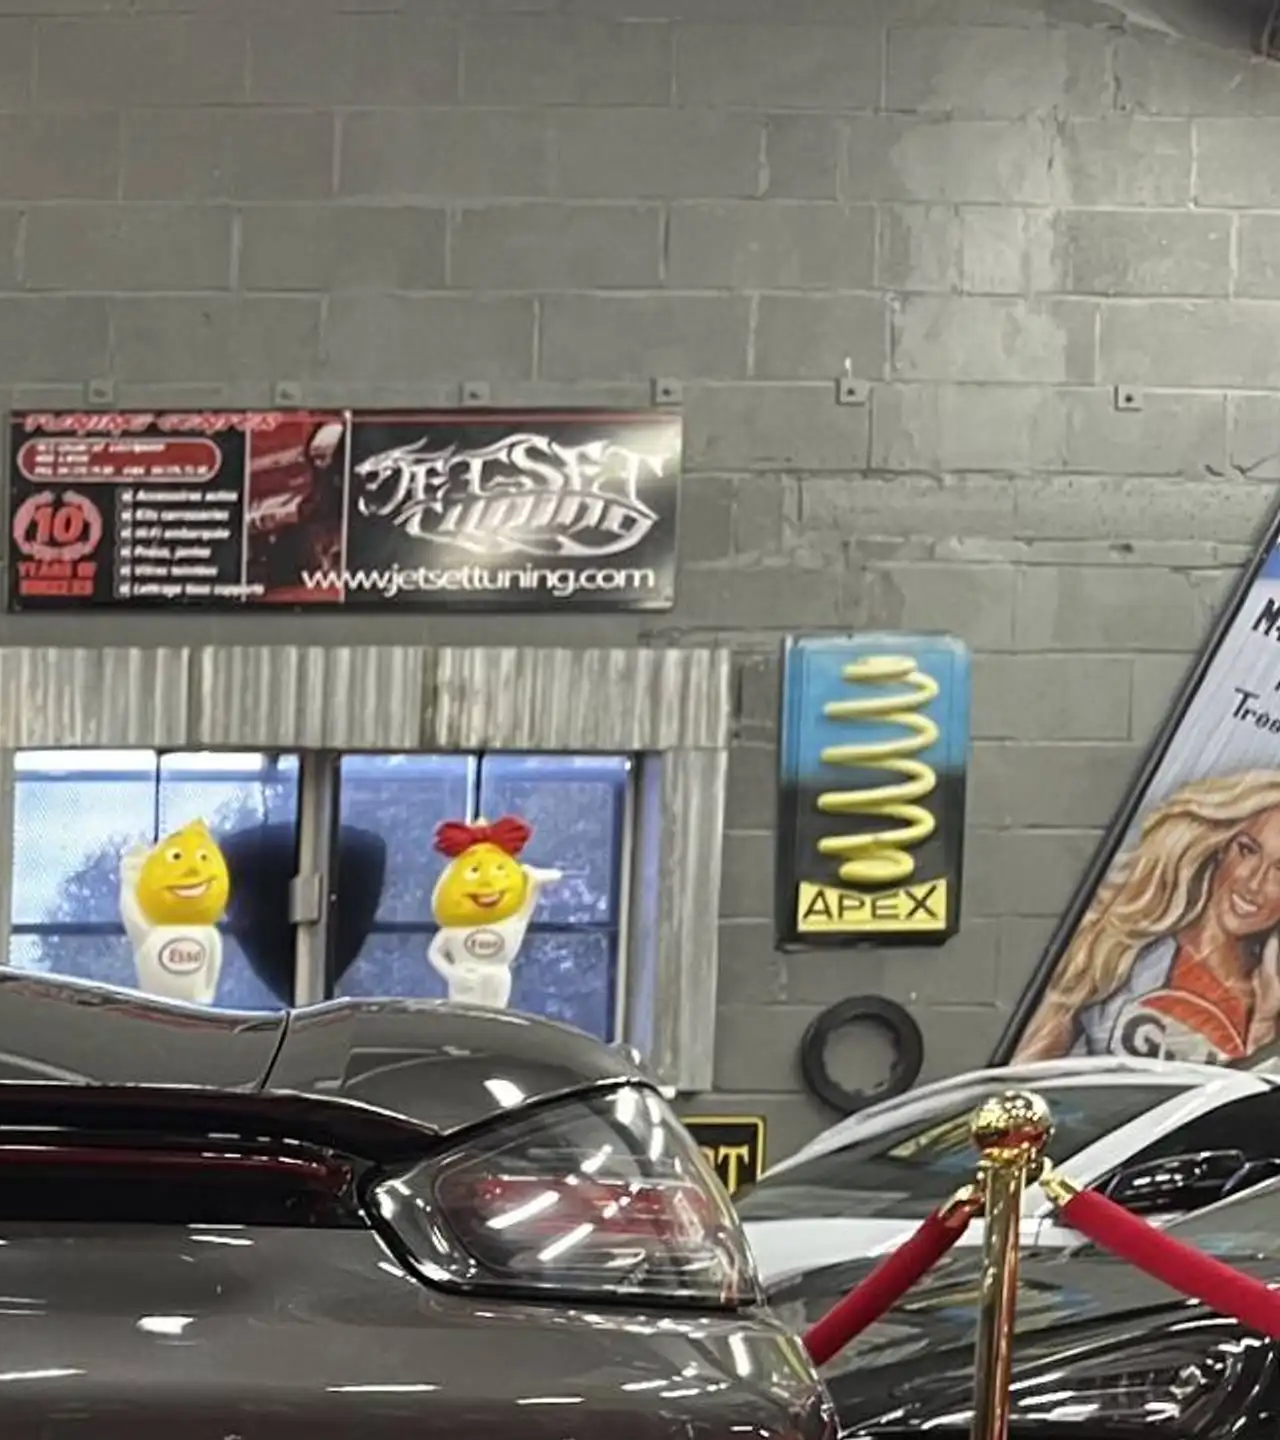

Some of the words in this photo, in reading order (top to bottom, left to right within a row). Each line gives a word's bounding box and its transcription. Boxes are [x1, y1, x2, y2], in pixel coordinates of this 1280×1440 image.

[34, 506, 84, 543] 10
[301, 562, 655, 598] www.jetsettuning.com
[802, 884, 939, 920] APEX
